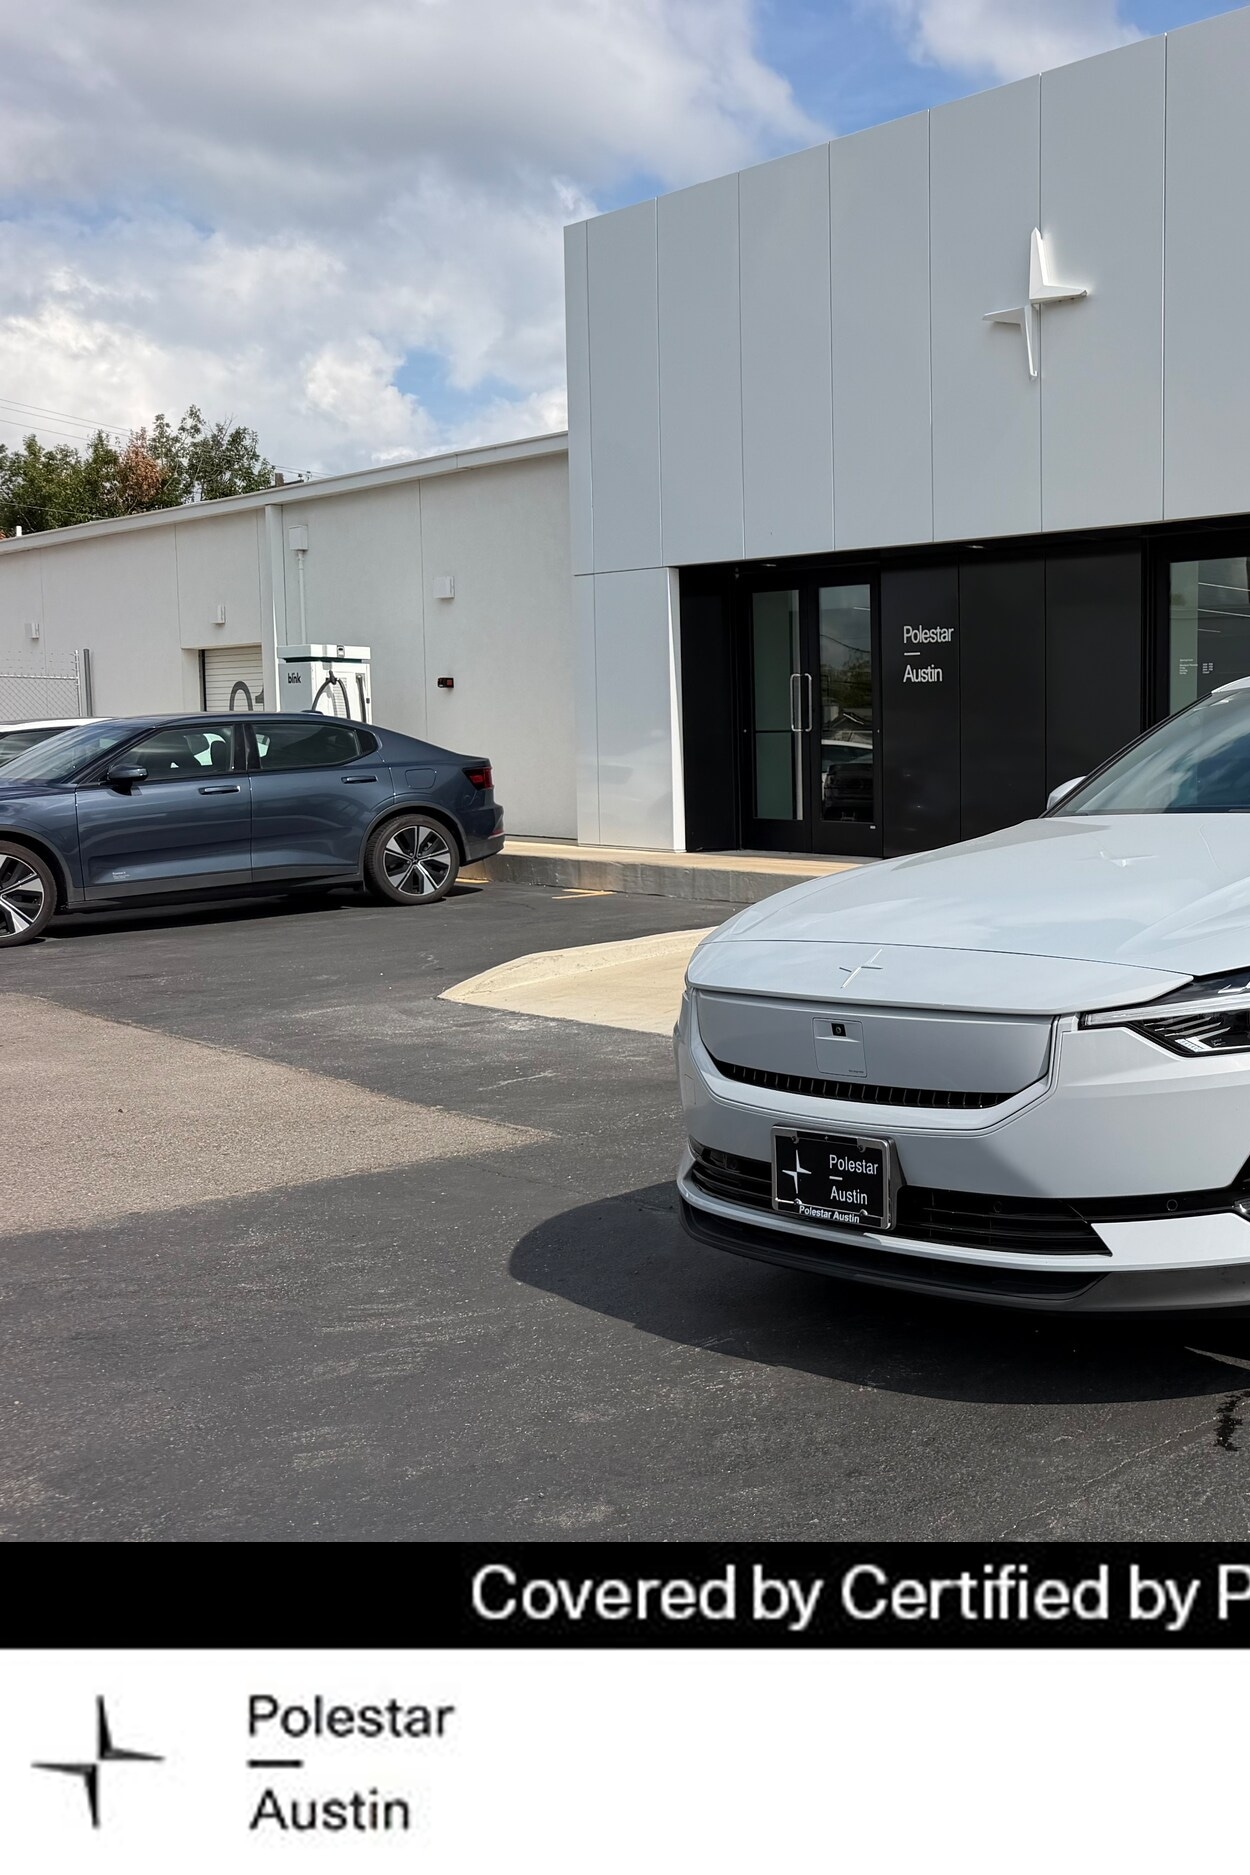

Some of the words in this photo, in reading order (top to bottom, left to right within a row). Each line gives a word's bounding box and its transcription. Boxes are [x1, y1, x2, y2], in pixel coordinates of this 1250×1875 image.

[903, 624, 955, 644] Polestar
[287, 672, 302, 684] blink
[903, 664, 943, 683] Austin
[828, 1153, 879, 1176] Polestar
[829, 1184, 868, 1206] Austin
[799, 1204, 832, 1219] Polestar
[832, 1210, 861, 1224] Austin
